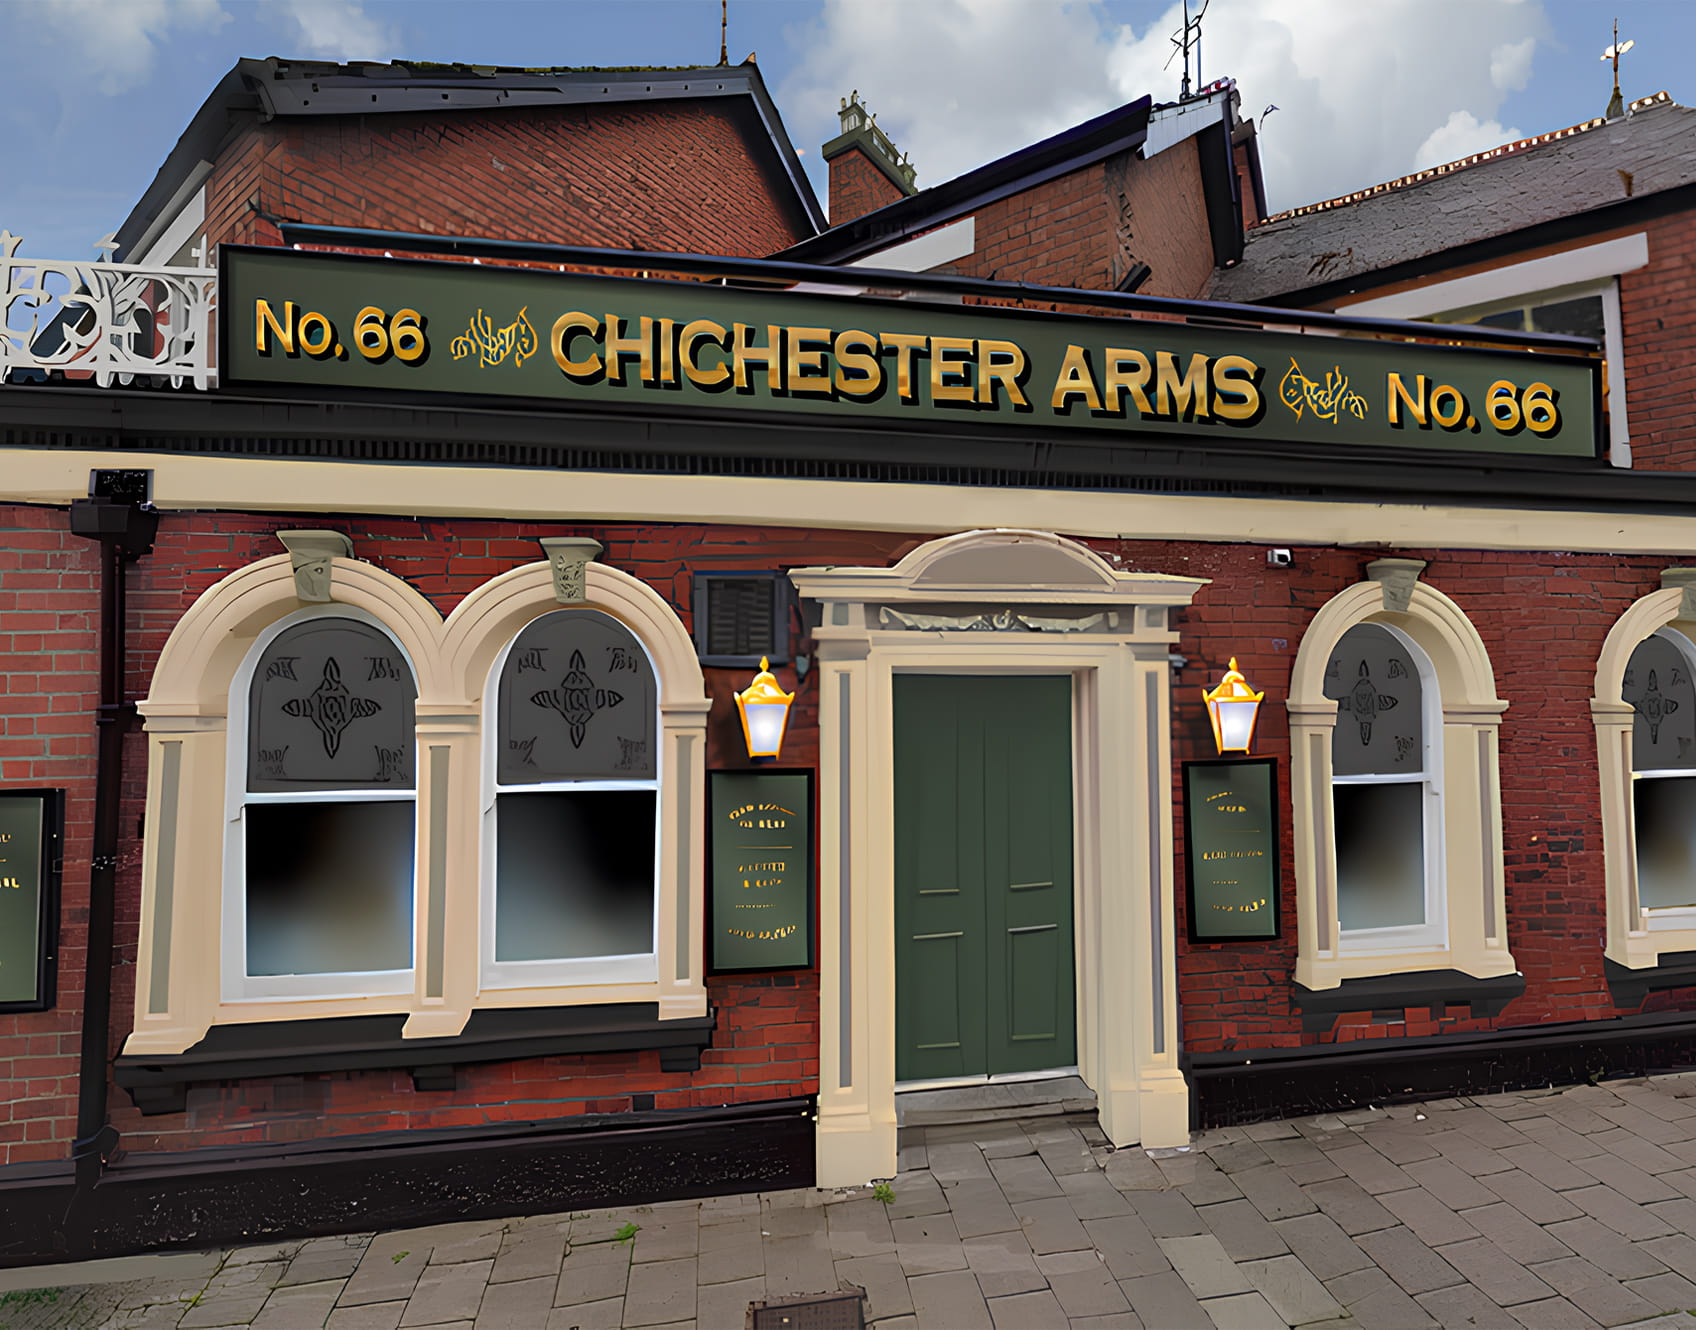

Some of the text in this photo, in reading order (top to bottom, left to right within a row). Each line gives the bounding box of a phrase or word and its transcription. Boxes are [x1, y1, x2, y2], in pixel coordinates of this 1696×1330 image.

[255, 299, 1558, 432] No. 66 CHICHESTER ARMS No. 66
